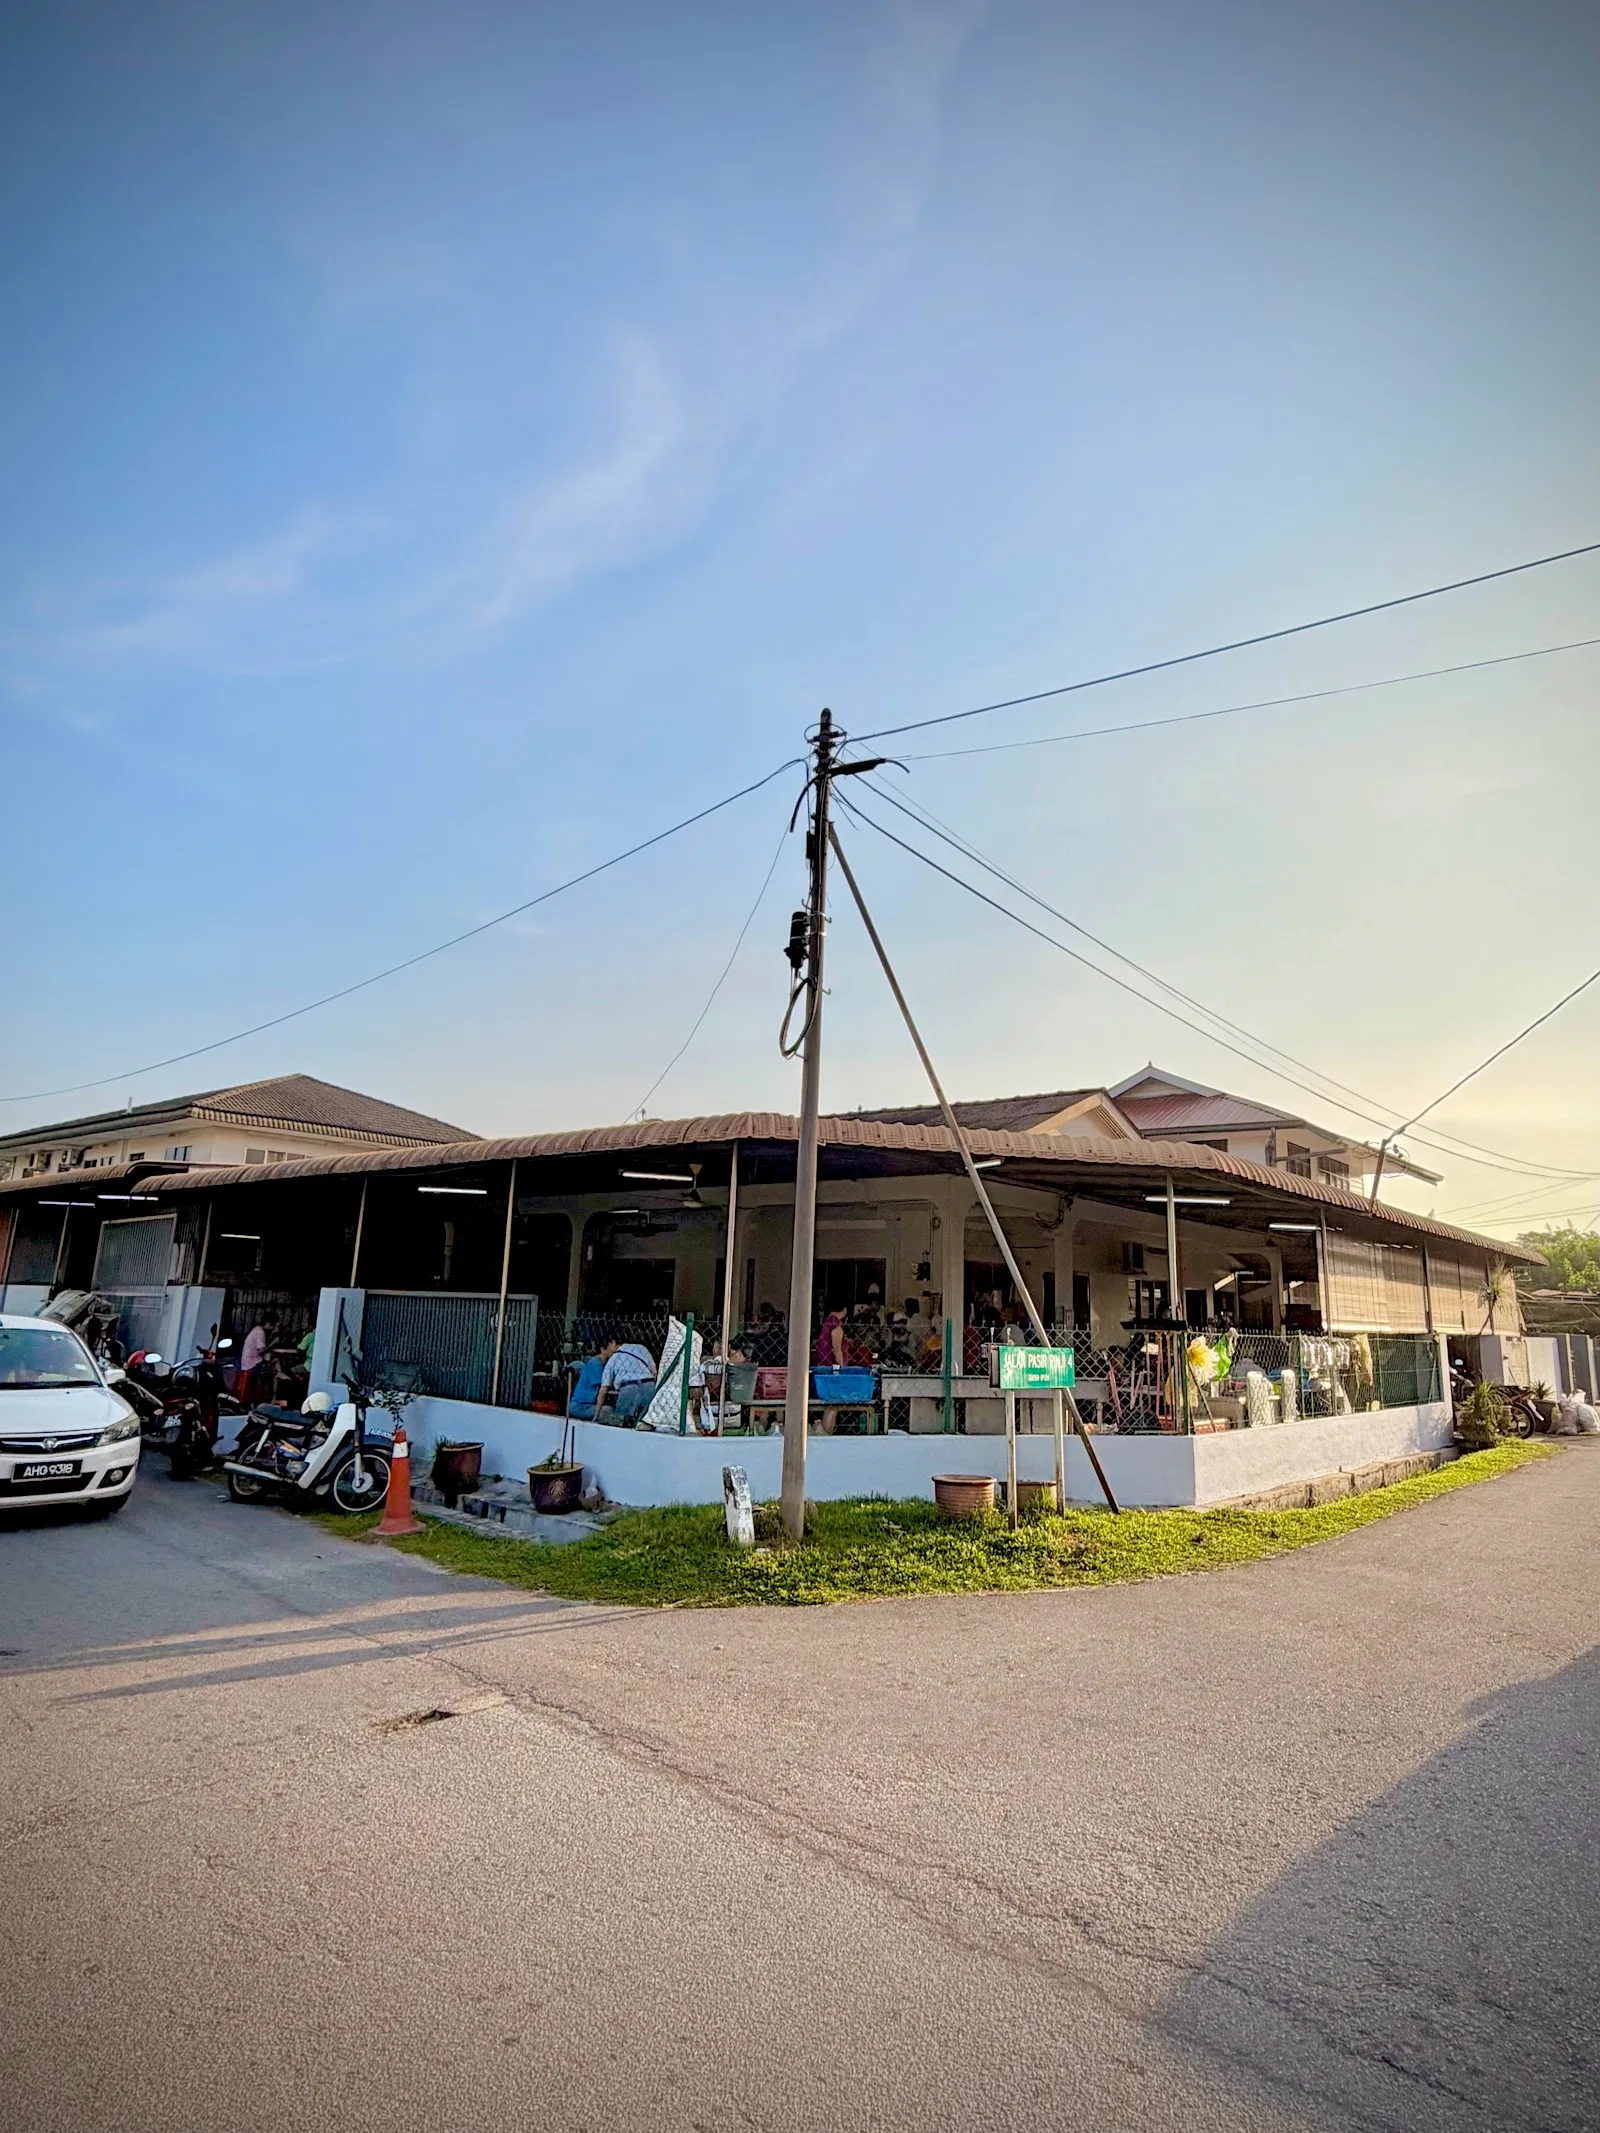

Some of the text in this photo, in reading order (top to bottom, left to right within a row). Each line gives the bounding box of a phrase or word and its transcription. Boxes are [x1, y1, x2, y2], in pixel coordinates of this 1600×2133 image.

[1003, 1352, 1026, 1368] JALAN
[1028, 1354, 1048, 1368] PASIR
[1067, 1354, 1073, 1368] 4
[48, 1463, 74, 1475] 9318
